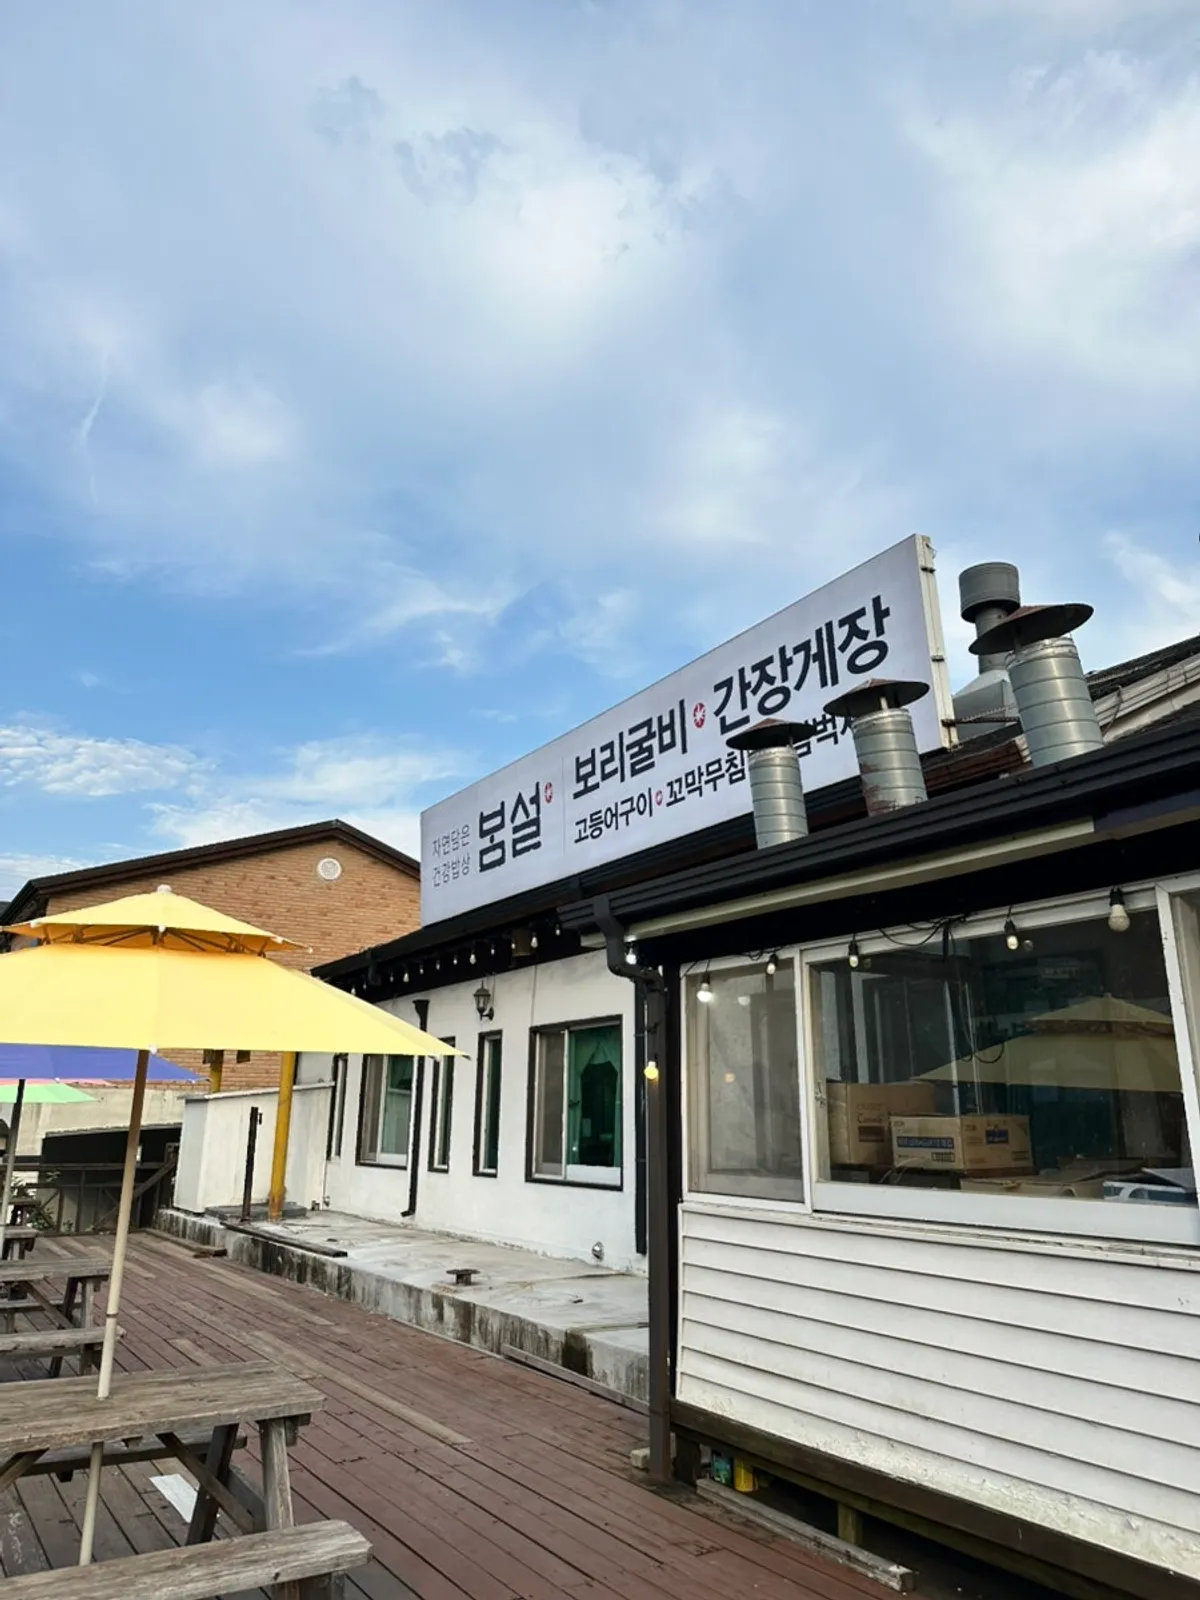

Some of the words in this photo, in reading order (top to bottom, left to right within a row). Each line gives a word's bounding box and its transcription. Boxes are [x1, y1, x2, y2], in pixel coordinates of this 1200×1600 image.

[572, 698, 688, 800] 보리굴비
[713, 594, 891, 736] 간장게장
[431, 823, 471, 858] 자연담은
[479, 781, 542, 873] 봄설
[574, 786, 653, 844] 고등어구이
[665, 750, 747, 807] 꼬막무침
[432, 851, 471, 887] 건강밥상
